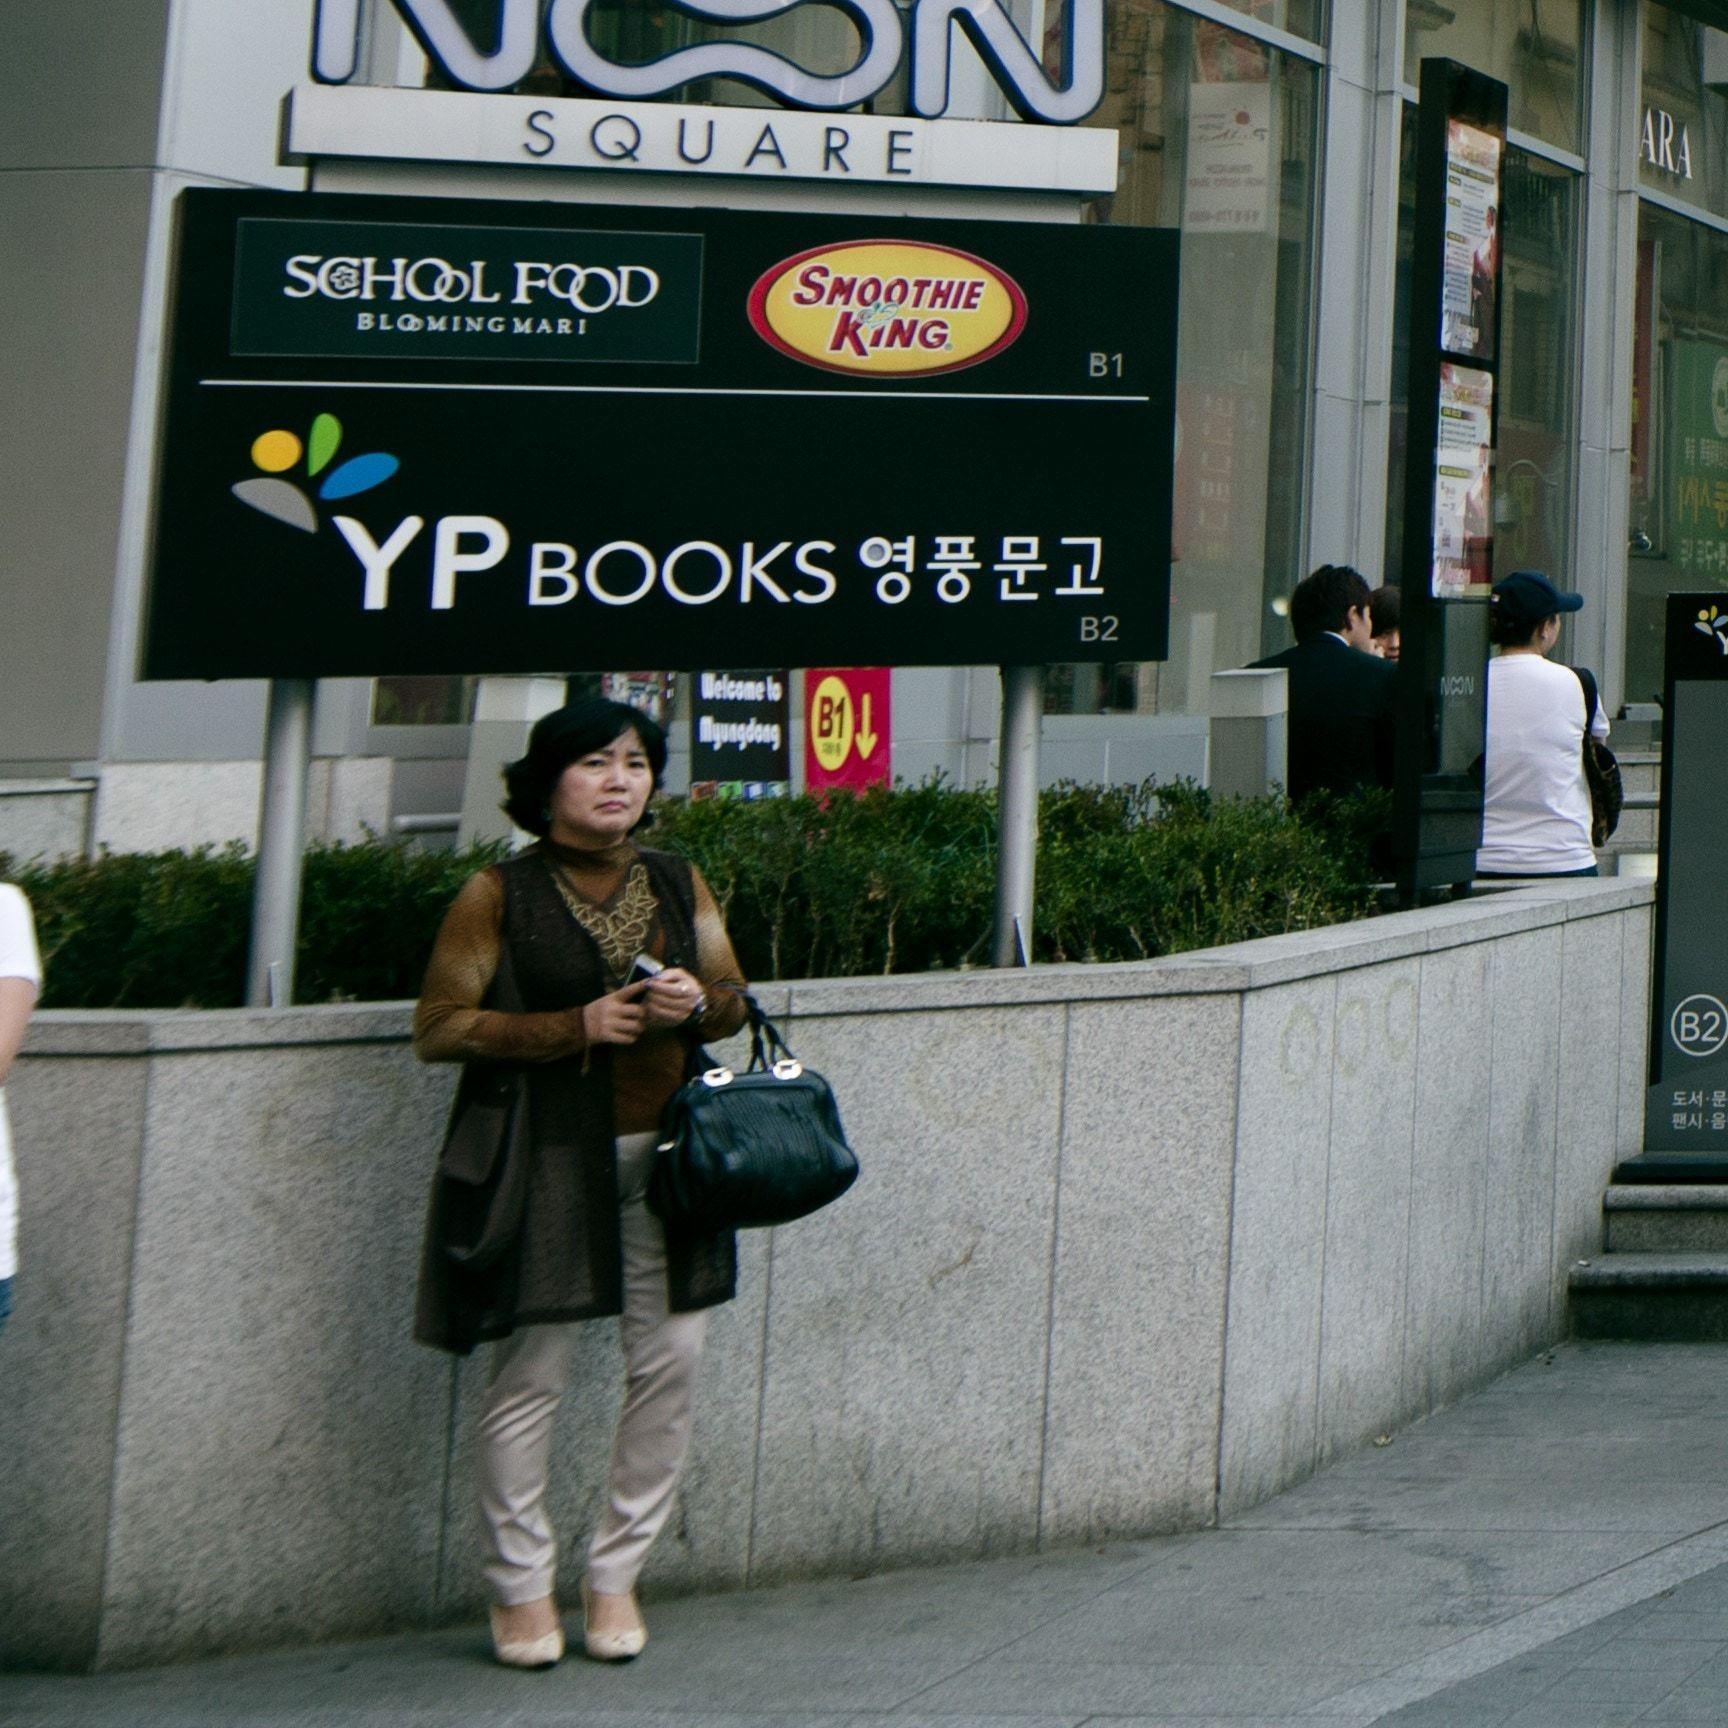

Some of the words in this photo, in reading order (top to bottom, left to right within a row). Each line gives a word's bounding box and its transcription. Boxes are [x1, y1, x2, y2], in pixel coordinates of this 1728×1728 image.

[521, 107, 919, 176] SQUARE
[1637, 105, 1693, 180] ARA
[282, 253, 502, 306] SCHOOL
[512, 260, 661, 313] FOOD
[790, 263, 984, 314] SMOOTHIE
[356, 309, 507, 335] BLOOMING
[510, 313, 588, 336] MARI
[829, 305, 949, 356] KING
[1088, 352, 1126, 380] B1
[333, 514, 512, 611] YP
[528, 539, 838, 607] BOOKS
[858, 534, 1105, 604] 영풍문고
[1079, 616, 1120, 644] B2
[700, 672, 763, 701] Welcome
[766, 673, 782, 701] to
[699, 716, 781, 751] Myungdong
[818, 695, 846, 739] B1
[1680, 1008, 1722, 1042] B2
